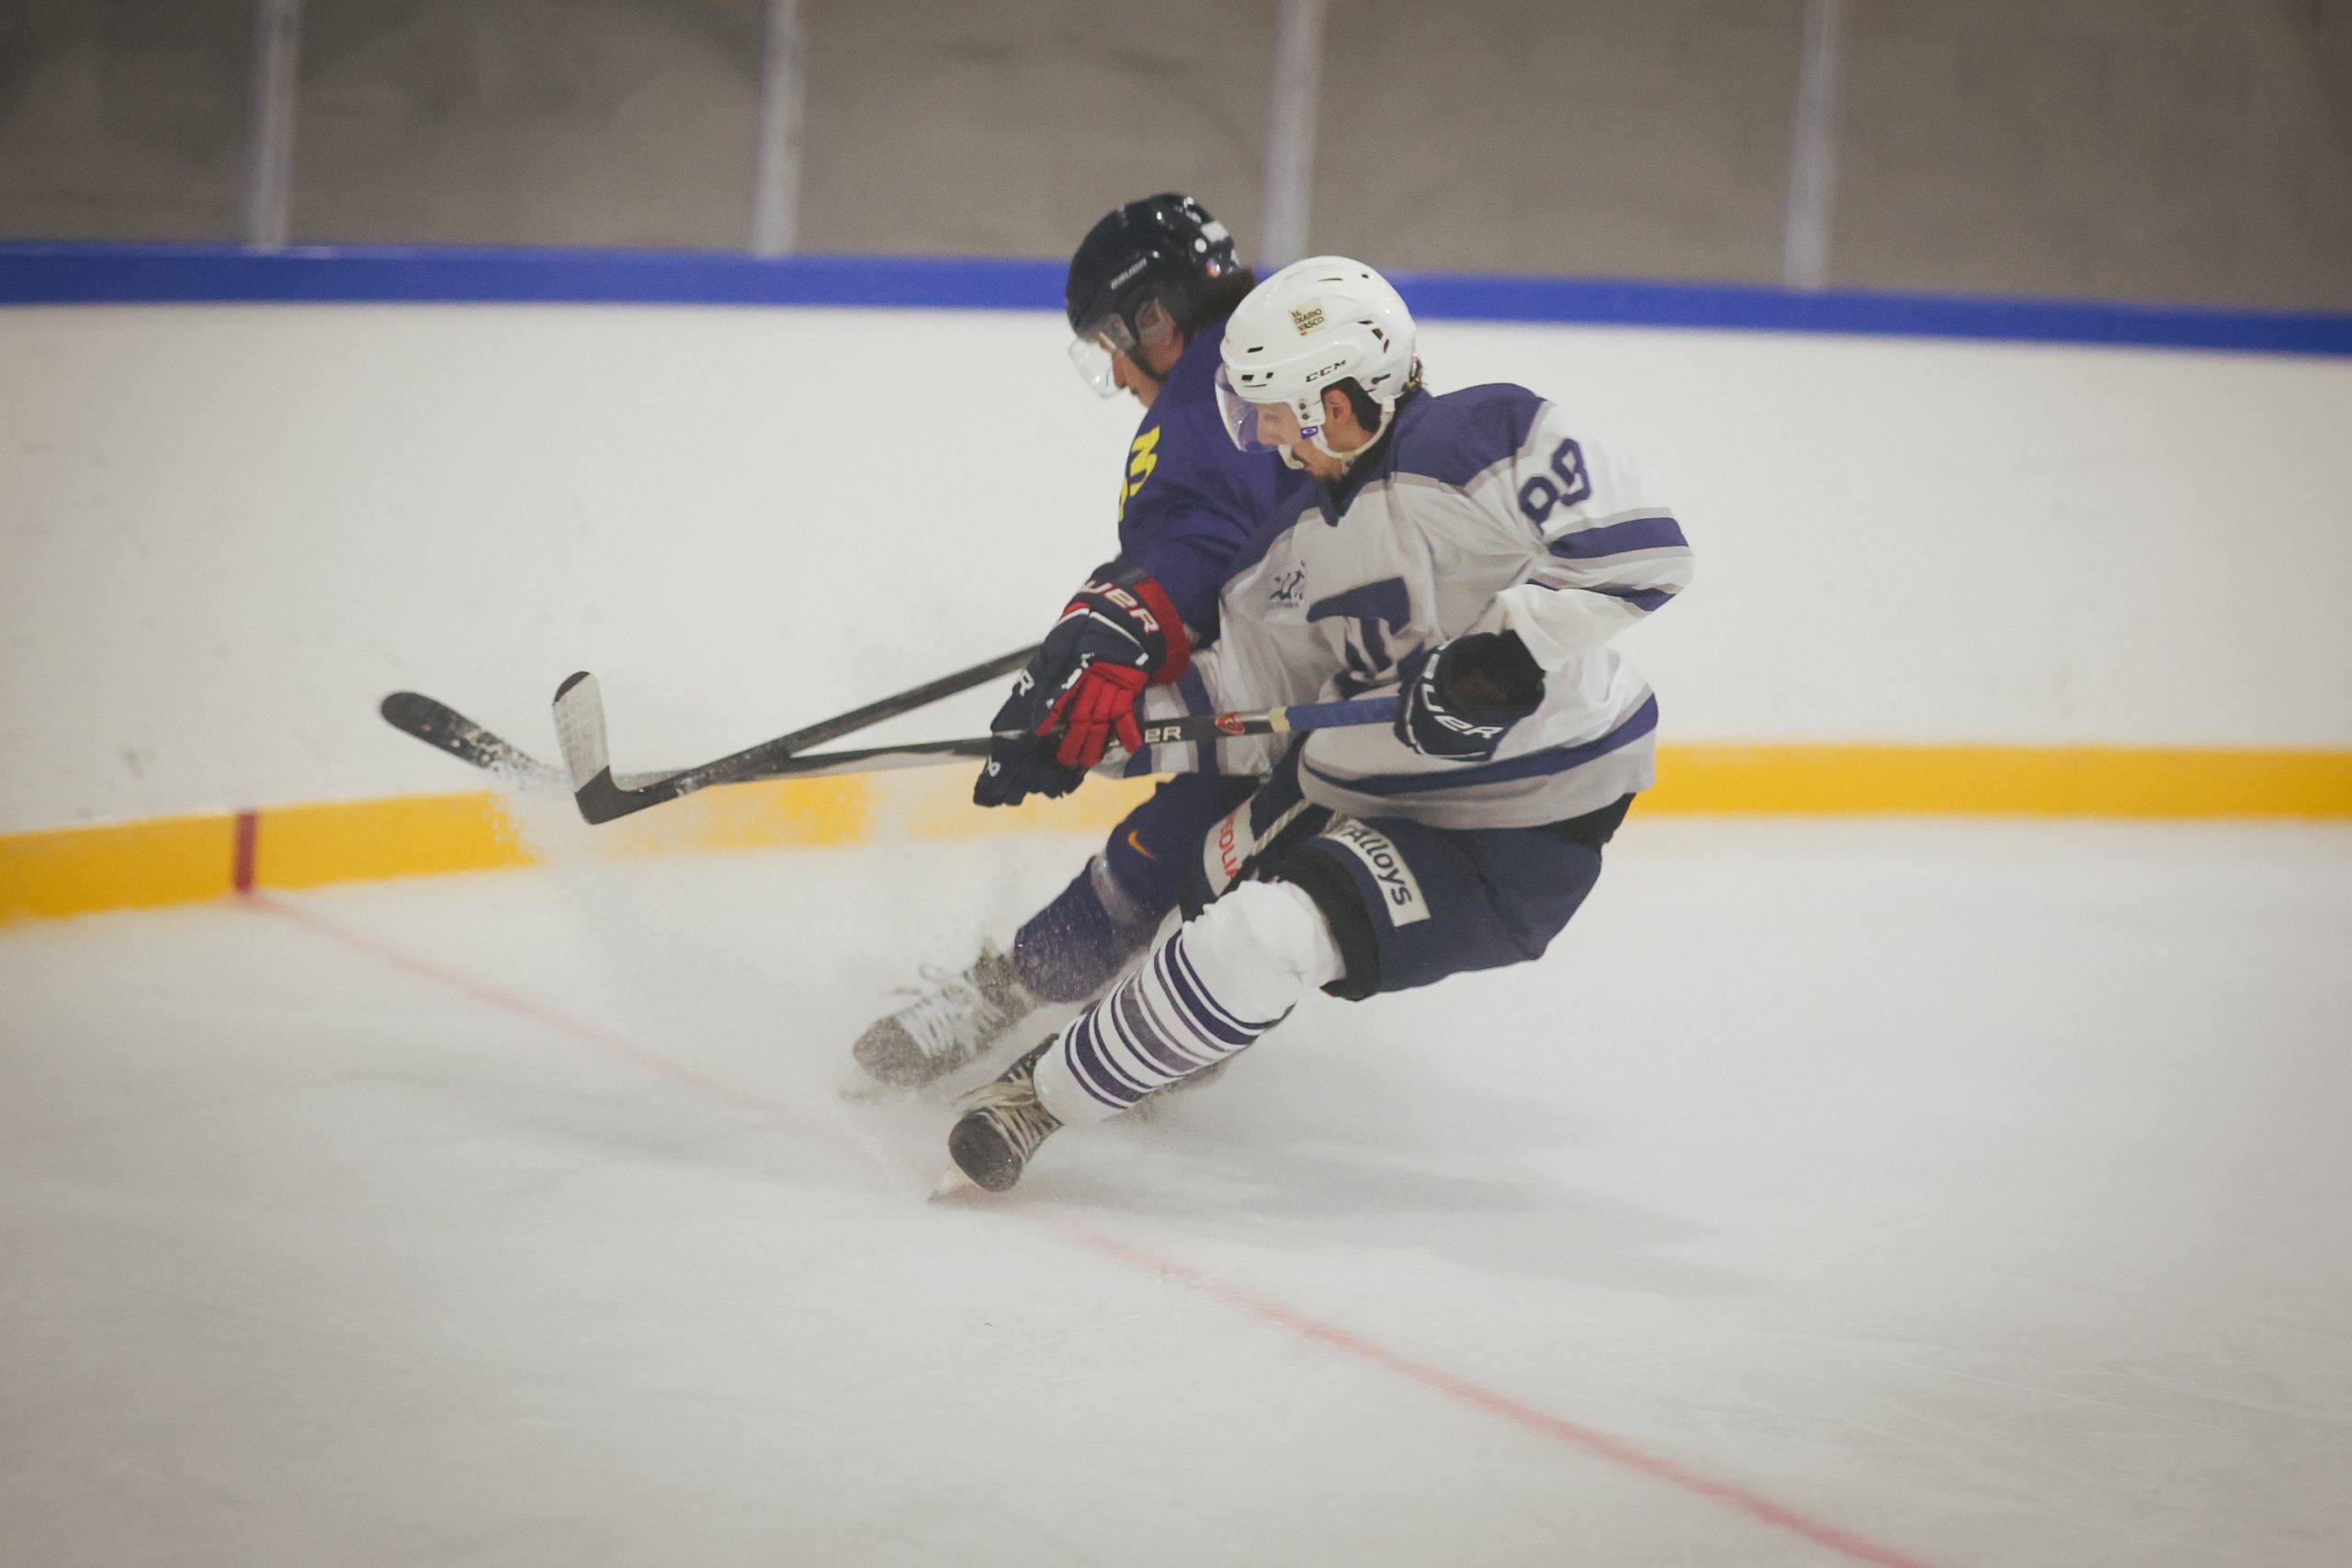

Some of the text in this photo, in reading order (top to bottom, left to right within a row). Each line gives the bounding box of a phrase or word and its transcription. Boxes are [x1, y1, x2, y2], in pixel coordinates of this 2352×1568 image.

[1297, 316, 1324, 332] VASCO
[1306, 359, 1346, 382] CCM
[1340, 828, 1413, 907] Alloys
